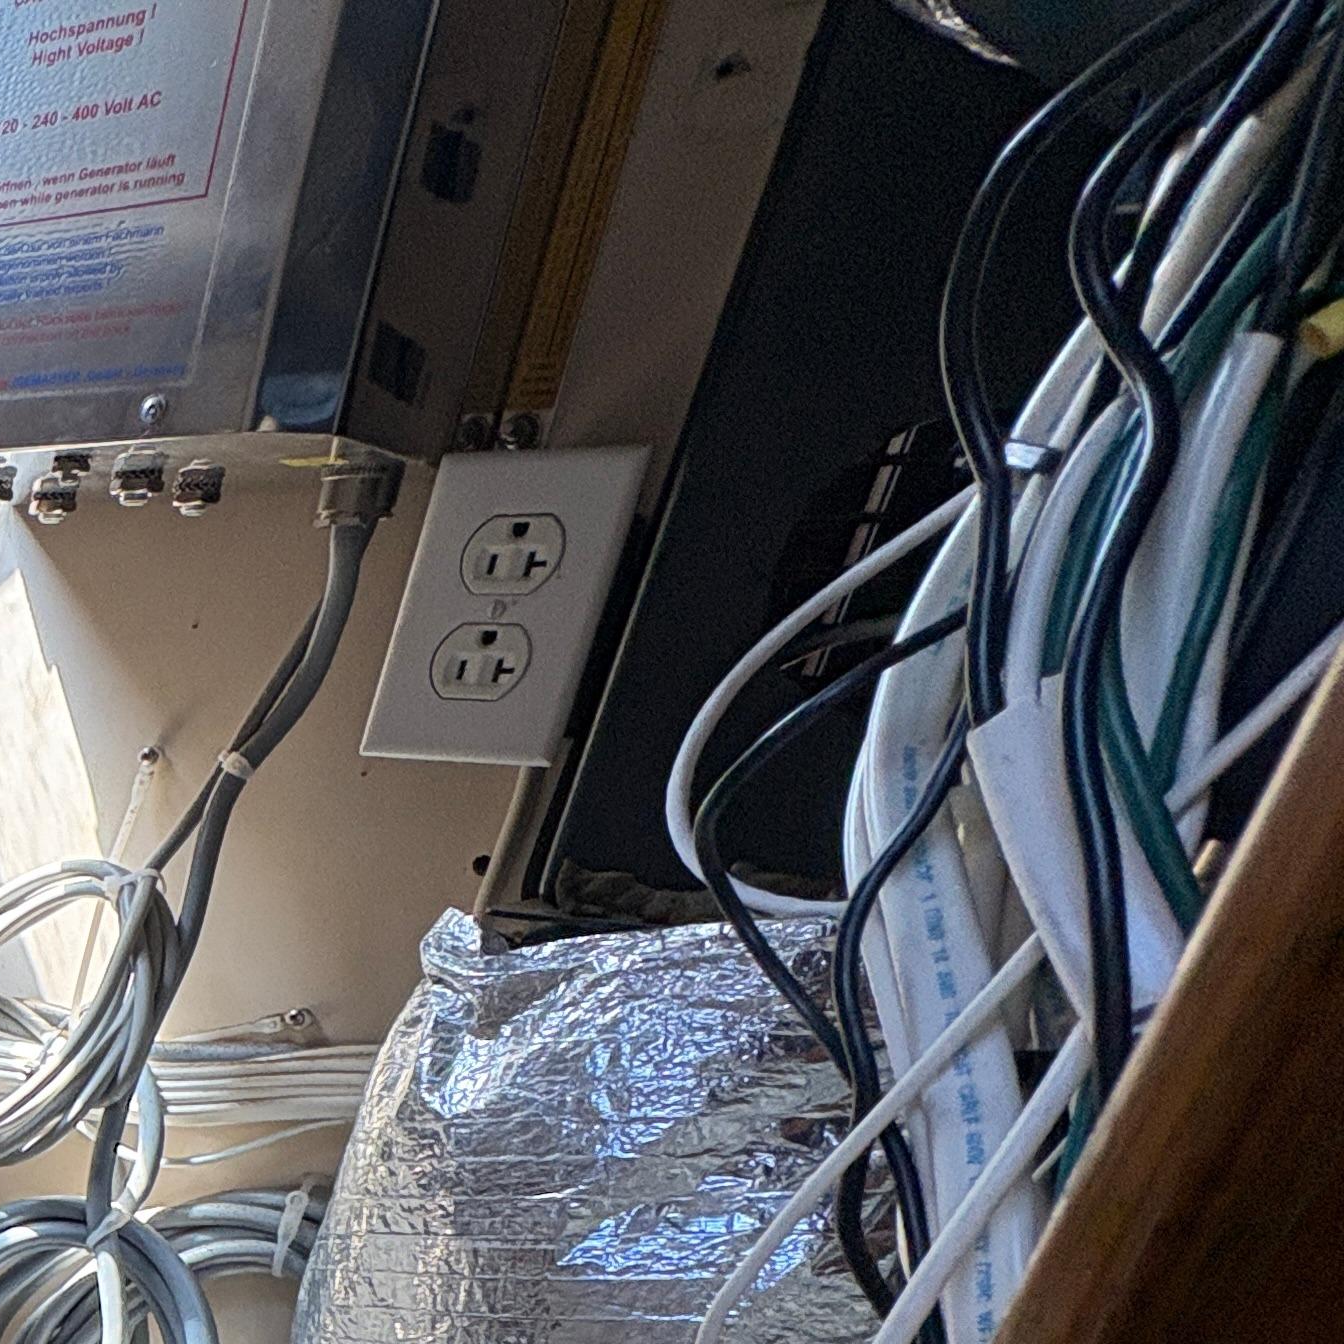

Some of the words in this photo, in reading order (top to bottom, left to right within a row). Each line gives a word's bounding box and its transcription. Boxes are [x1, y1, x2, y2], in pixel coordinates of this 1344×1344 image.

[28, 9, 146, 46] Hochspannung
[31, 50, 72, 67] Hight
[77, 34, 135, 57] Voltage
[31, 110, 59, 130] 240
[71, 103, 99, 121] 400
[104, 97, 133, 116] Volt
[137, 90, 162, 110] AC
[20, 191, 52, 207] while
[54, 183, 116, 205] generator
[117, 179, 131, 193] is
[132, 171, 185, 189] running
[42, 172, 75, 188] wenn
[78, 161, 143, 181] Generator
